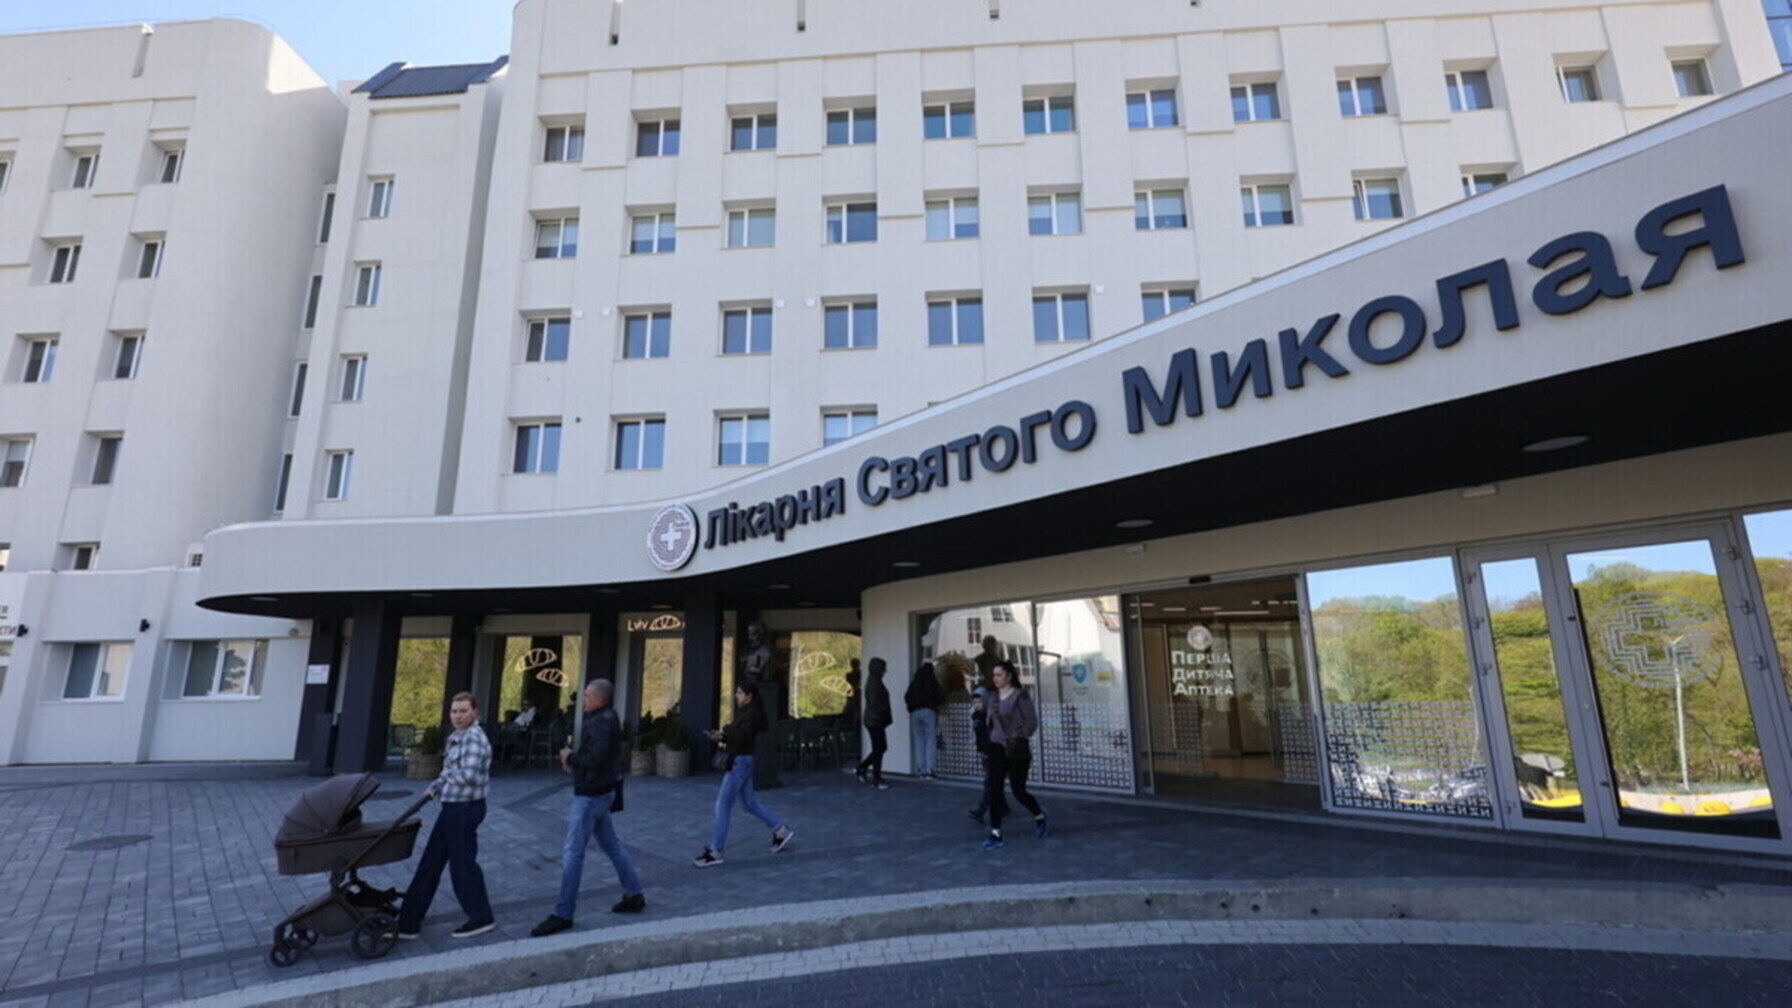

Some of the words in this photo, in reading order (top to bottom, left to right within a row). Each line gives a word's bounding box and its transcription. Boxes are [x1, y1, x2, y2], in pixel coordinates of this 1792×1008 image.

[704, 476, 846, 550] Лікарня
[856, 400, 1097, 507] Святого
[1121, 183, 1746, 434] Миколая
